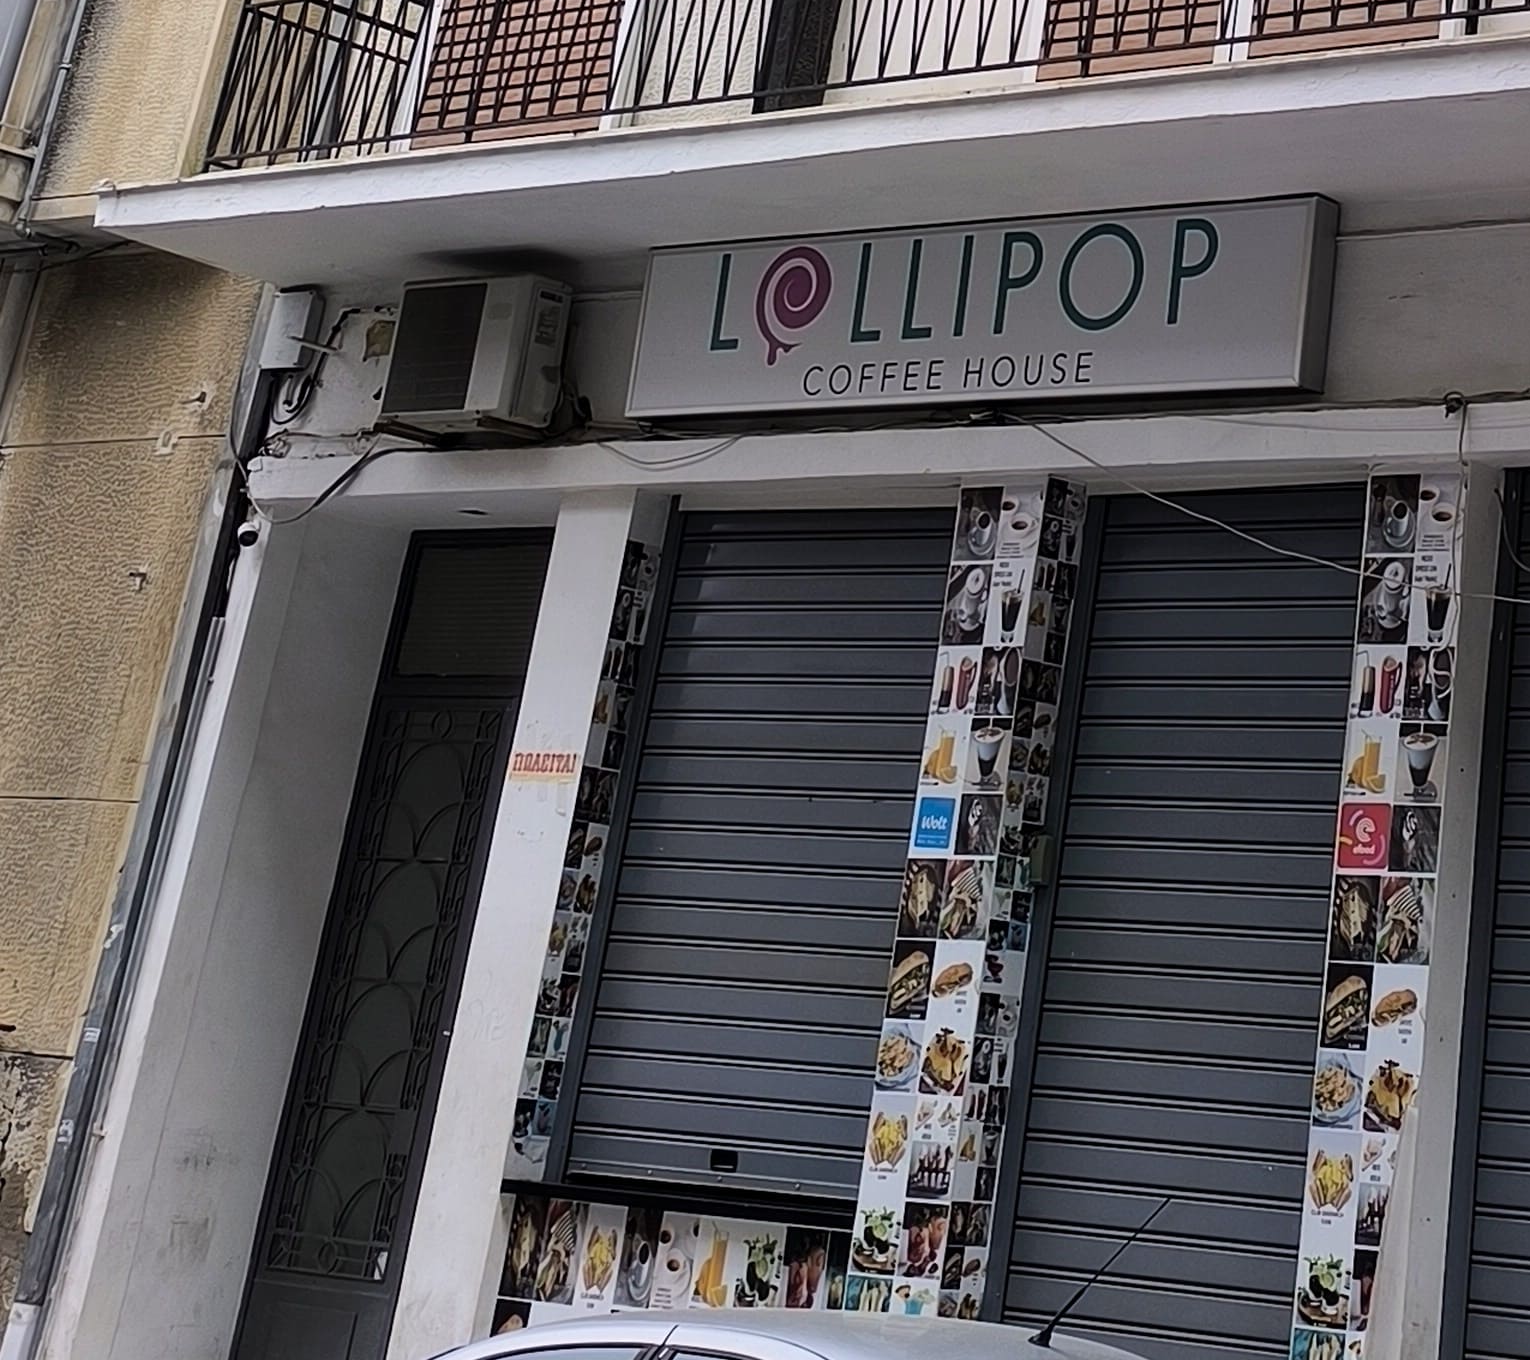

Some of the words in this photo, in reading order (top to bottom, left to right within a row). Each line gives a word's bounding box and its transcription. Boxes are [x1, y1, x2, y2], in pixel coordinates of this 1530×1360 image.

[709, 218, 1220, 364] LOLLIPOP
[803, 361, 944, 396] COFFEE
[963, 352, 1094, 388] HOUSE
